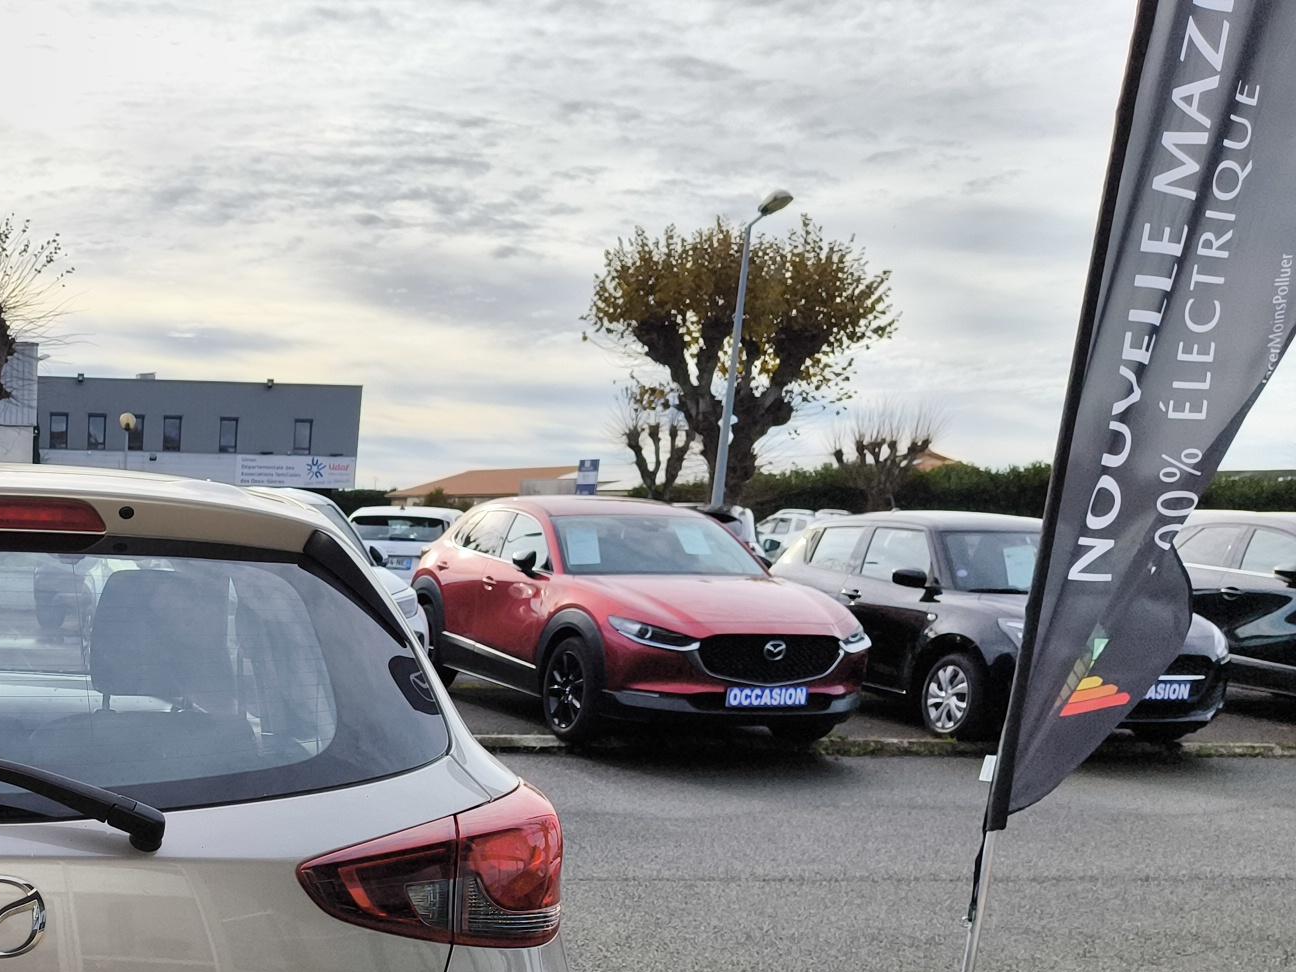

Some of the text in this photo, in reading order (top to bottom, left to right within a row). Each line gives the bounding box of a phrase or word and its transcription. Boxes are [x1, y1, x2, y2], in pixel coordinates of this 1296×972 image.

[1067, 0, 1234, 582] NOUVELLE MAZ
[1158, 80, 1260, 420] ÉLECTRIQUE
[729, 686, 806, 706] OCCASION
[1145, 683, 1190, 700] ASION
